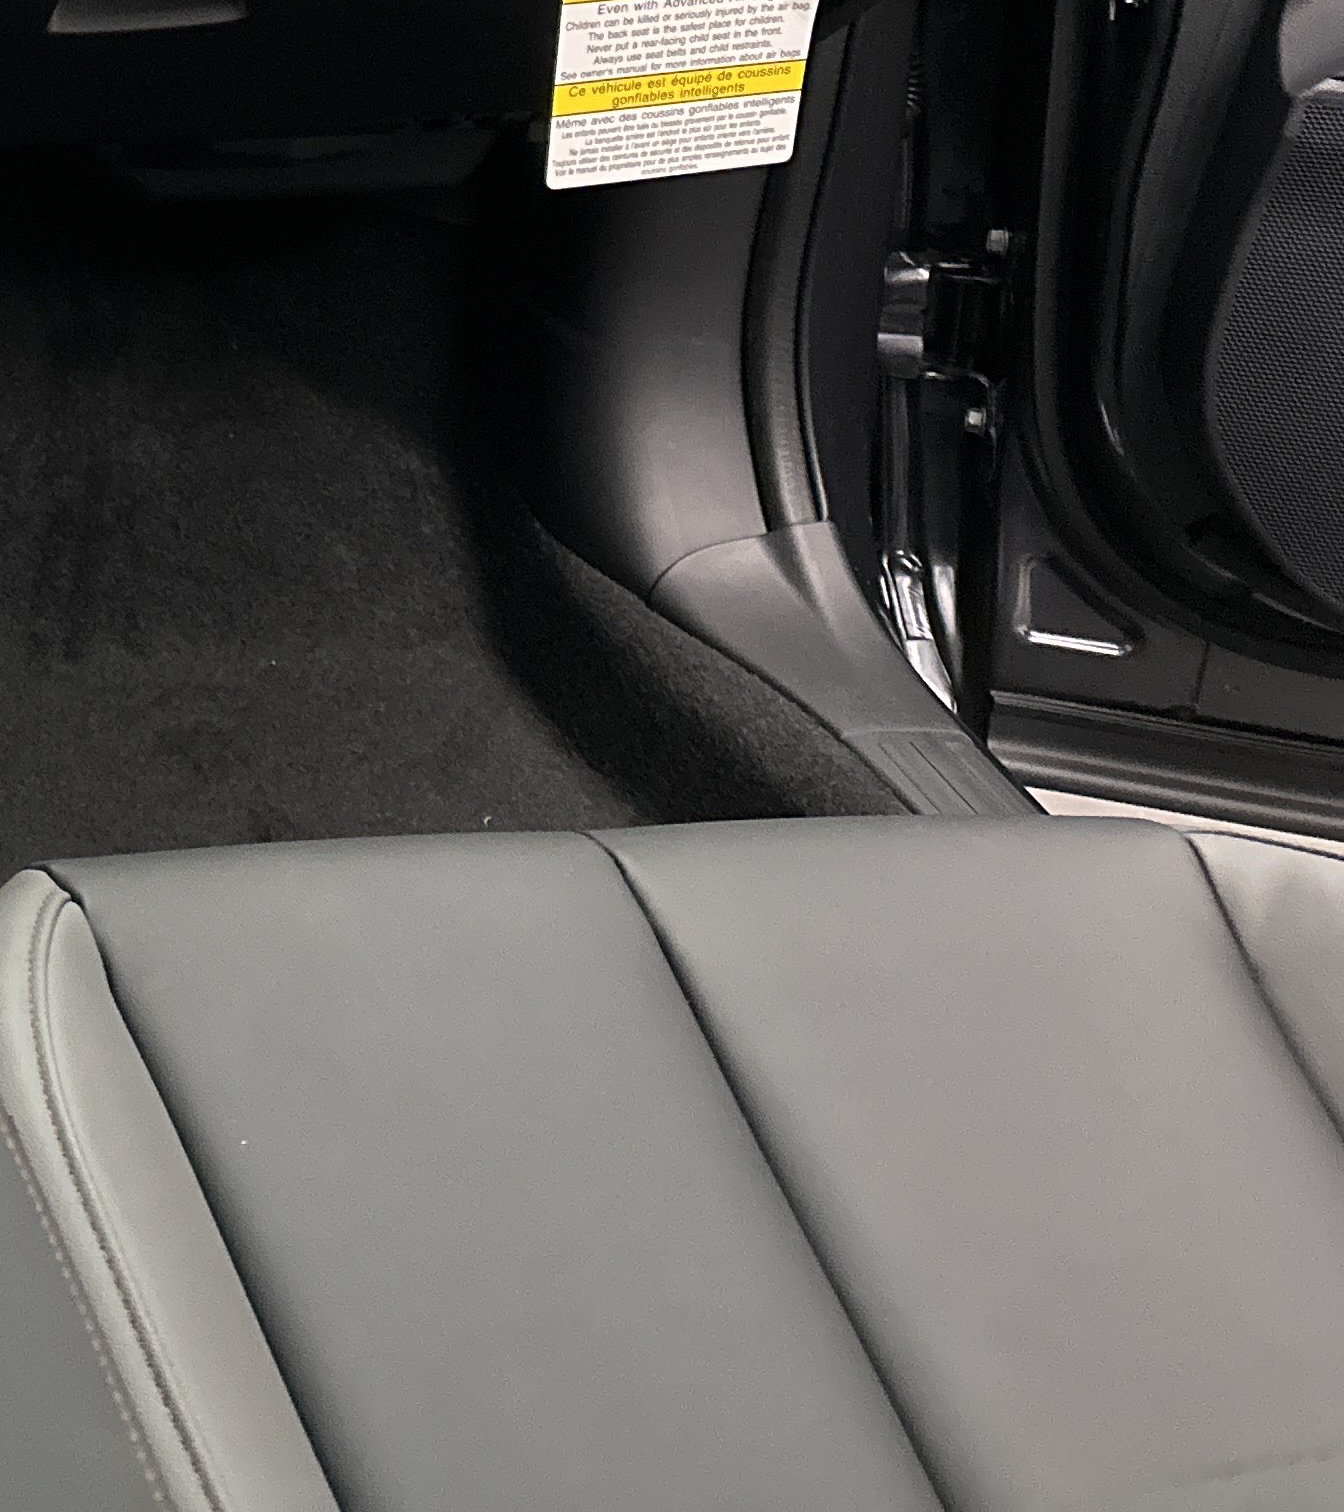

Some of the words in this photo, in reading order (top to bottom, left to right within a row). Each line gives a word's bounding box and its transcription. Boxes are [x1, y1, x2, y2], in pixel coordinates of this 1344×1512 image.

[597, 4, 629, 15] Even
[634, 0, 658, 11] with
[569, 86, 586, 97] Ce
[592, 80, 642, 95] véhicule
[648, 77, 666, 89] est
[671, 72, 712, 86] équipé
[717, 71, 733, 82] de
[738, 66, 791, 79] coussins
[612, 91, 675, 108] gonflables
[680, 83, 745, 99] intelligents
